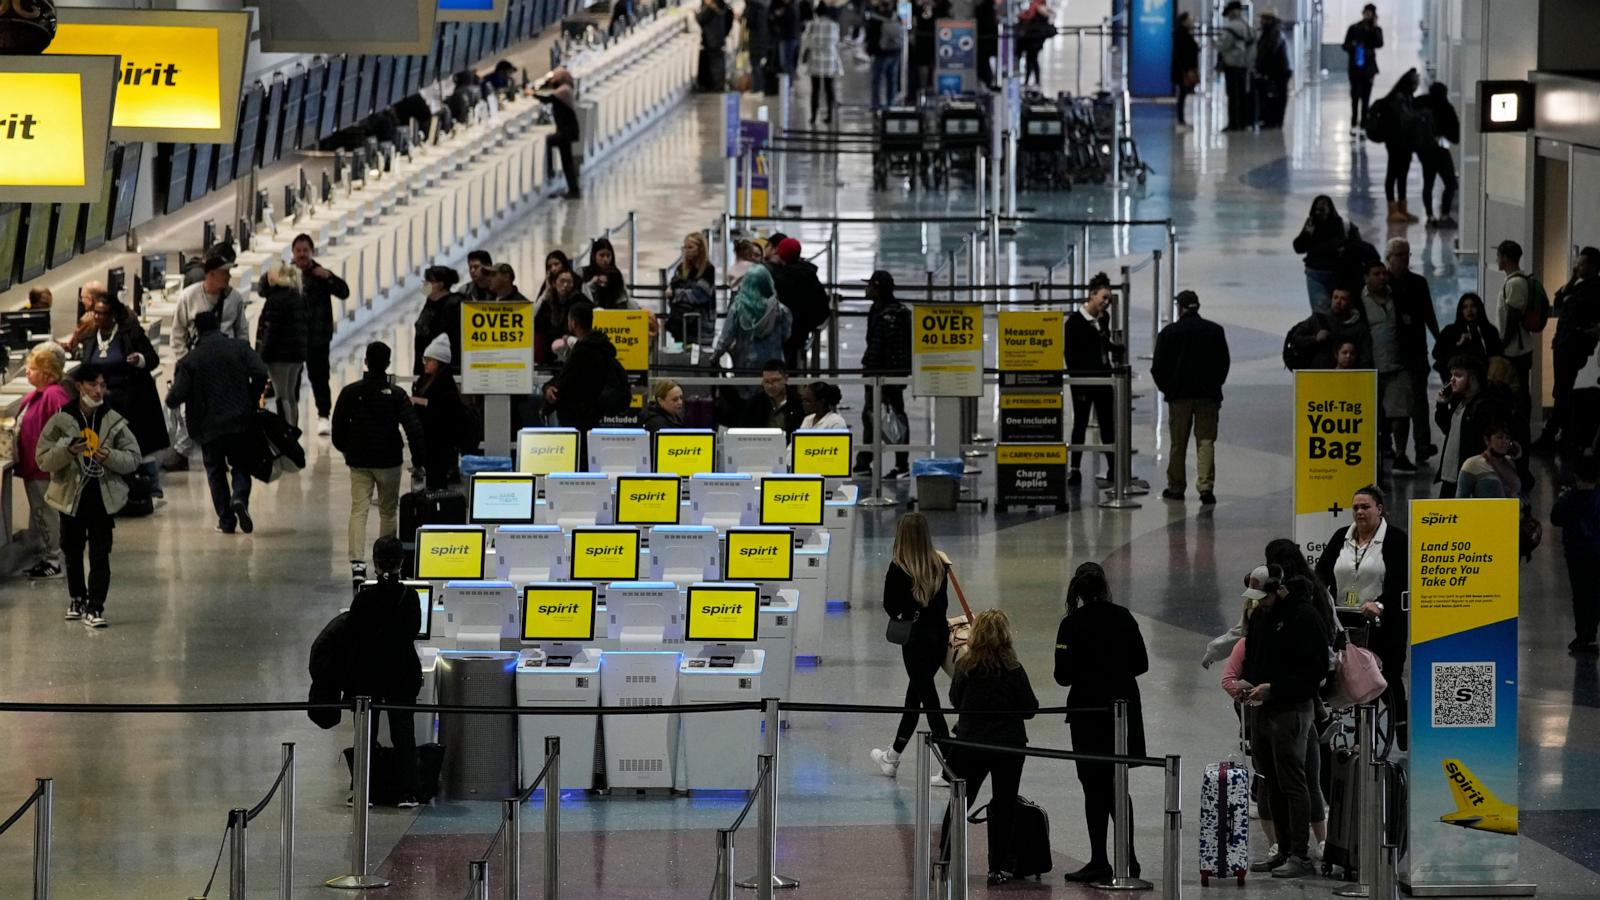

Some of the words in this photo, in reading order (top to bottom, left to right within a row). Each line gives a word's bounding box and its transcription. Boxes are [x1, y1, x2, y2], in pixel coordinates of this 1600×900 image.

[118, 62, 178, 86] irit
[472, 313, 524, 328] OVER
[922, 316, 973, 330] OVER
[471, 331, 487, 342] 40
[491, 331, 524, 342] LBS?
[1004, 328, 1045, 336] Measure
[615, 336, 639, 346] Bags
[922, 334, 938, 345] 40
[942, 334, 974, 345] LBS?
[1030, 338, 1053, 348] Bags
[1308, 400, 1362, 415] Self-Tag
[603, 415, 638, 424] Included
[1006, 417, 1021, 425] One
[1023, 417, 1057, 425] Included
[1307, 414, 1363, 434] Your
[530, 446, 566, 456] spirit
[667, 446, 702, 457] spirit
[804, 447, 839, 457] spirit
[1309, 436, 1362, 466] Bag
[1016, 469, 1047, 479] Charge
[1015, 479, 1048, 489] Applies
[629, 491, 667, 503] spirit
[773, 492, 810, 503] spirit
[1421, 514, 1458, 526] spirit
[430, 544, 470, 556] spirit
[585, 545, 625, 557] spirit
[739, 546, 778, 557] spirit
[1420, 541, 1449, 551] Land
[1451, 541, 1471, 551] 500
[1420, 554, 1455, 563] Bonus
[1457, 552, 1493, 563] Points
[1420, 565, 1457, 575] Before
[1460, 565, 1480, 575] You
[1421, 577, 1446, 587] Take
[1449, 576, 1468, 586] Off
[538, 603, 580, 615] spirit
[701, 603, 744, 616] spirit
[1446, 762, 1485, 806] spirit
